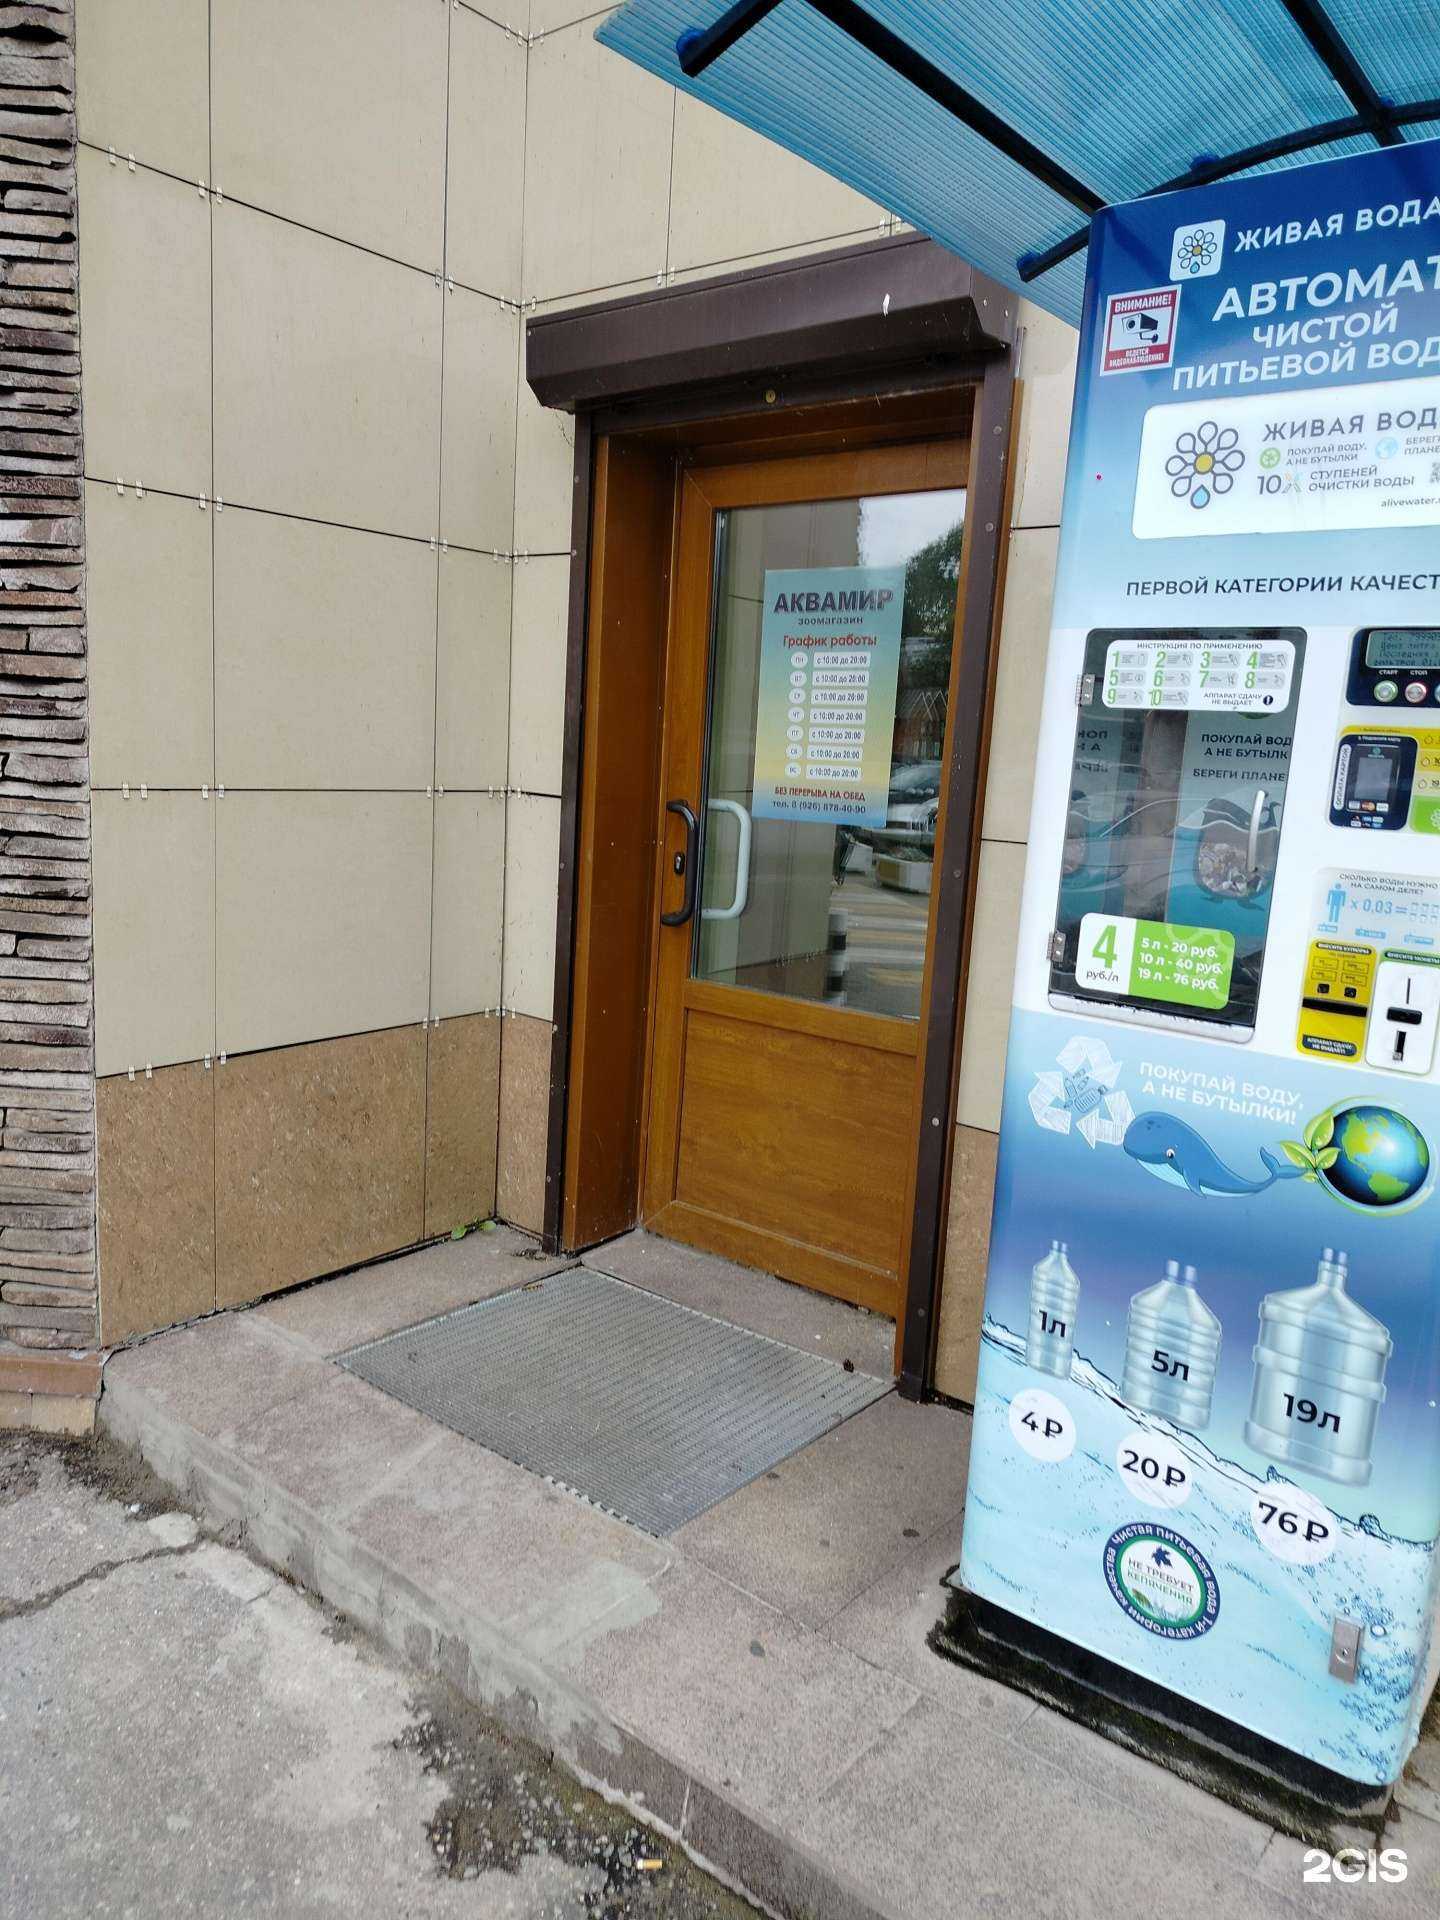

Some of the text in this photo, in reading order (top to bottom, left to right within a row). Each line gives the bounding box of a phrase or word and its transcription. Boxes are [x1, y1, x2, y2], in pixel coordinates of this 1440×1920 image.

[1234, 196, 1440, 253] ЖИВАЯ ВОДА
[1114, 293, 1172, 313] ВНИМАНИЕ!
[1252, 301, 1399, 349] ЧИСТОЙ
[1172, 341, 1356, 391] ПИТЬЕВОЙ
[1262, 415, 1364, 442] ЖИВАЯ
[1287, 444, 1334, 456] ПОКУПАЙ
[1297, 457, 1308, 465] НЕ
[1310, 453, 1358, 464] БУТЫЛКИ
[1310, 466, 1378, 480] СТУПЕНЕЙ
[1257, 474, 1282, 495] 10
[1308, 476, 1415, 492] ОЧИСТКИ ВОДЫ
[1126, 574, 1440, 596] ПЕРВОЙ КАТЕГОРИИ КАЧЕСТ
[774, 589, 893, 613] АКВАМИР
[798, 616, 863, 625] зоомагазин
[783, 633, 877, 649] График работы
[1136, 642, 1263, 650] ИНСТРУКЦИЯ ПО ПРИМЕНЕНИЮ
[823, 656, 838, 664] 10:00
[840, 657, 849, 666] до
[850, 656, 867, 664] 20:00
[1112, 651, 1120, 668] 1
[1155, 651, 1166, 668] 2
[1200, 651, 1211, 669] 3
[1246, 651, 1257, 669] 4
[839, 676, 847, 684] до
[1109, 670, 1119, 686] 5
[1154, 670, 1164, 687] 6
[1199, 670, 1210, 688] 7
[1244, 671, 1255, 689] 8
[820, 693, 836, 701] 10:00
[847, 693, 864, 701] 20:00
[1107, 688, 1116, 704] 9
[1148, 689, 1162, 706] 10
[819, 712, 835, 720] 10:00
[846, 712, 863, 720] 20:00
[845, 732, 861, 740] 20:00
[1202, 734, 1292, 747] ПОКУПАЙ ВОД
[816, 750, 832, 758] 10:00
[844, 750, 860, 759] 20:00
[1204, 748, 1288, 759] А НЕ БУТЫЛК
[815, 767, 831, 776] 10:00
[842, 768, 858, 777] 20:00
[1193, 769, 1285, 781] БЕРЕГИ ПЛАНЕ
[775, 787, 865, 802] БЕЗ ПЕРЕРЫВА НА ОБЕД
[773, 801, 789, 809] тел.
[792, 801, 797, 809] 8
[799, 801, 821, 812] (926)
[1339, 873, 1438, 890] СКОЛЬКО ВОДЫ НУЖНО
[1364, 884, 1395, 892] САМОМ
[1092, 924, 1118, 968] 4
[1141, 938, 1218, 958] 5 л 20 руб.
[1140, 952, 1223, 975] 10 л 40 руб.
[1086, 970, 1119, 984] руб./л
[1138, 967, 1219, 991] 19 л 76 руб.
[1139, 1062, 1305, 1110] ПОКУПАЙ ВОДУ,
[1141, 1081, 1297, 1125] А НЕ БУТЫЛКИ!
[1038, 1310, 1067, 1339] 1л
[1150, 1350, 1190, 1381] 5л
[1283, 1393, 1341, 1433] 19л
[1128, 1557, 1143, 1569] НЕ
